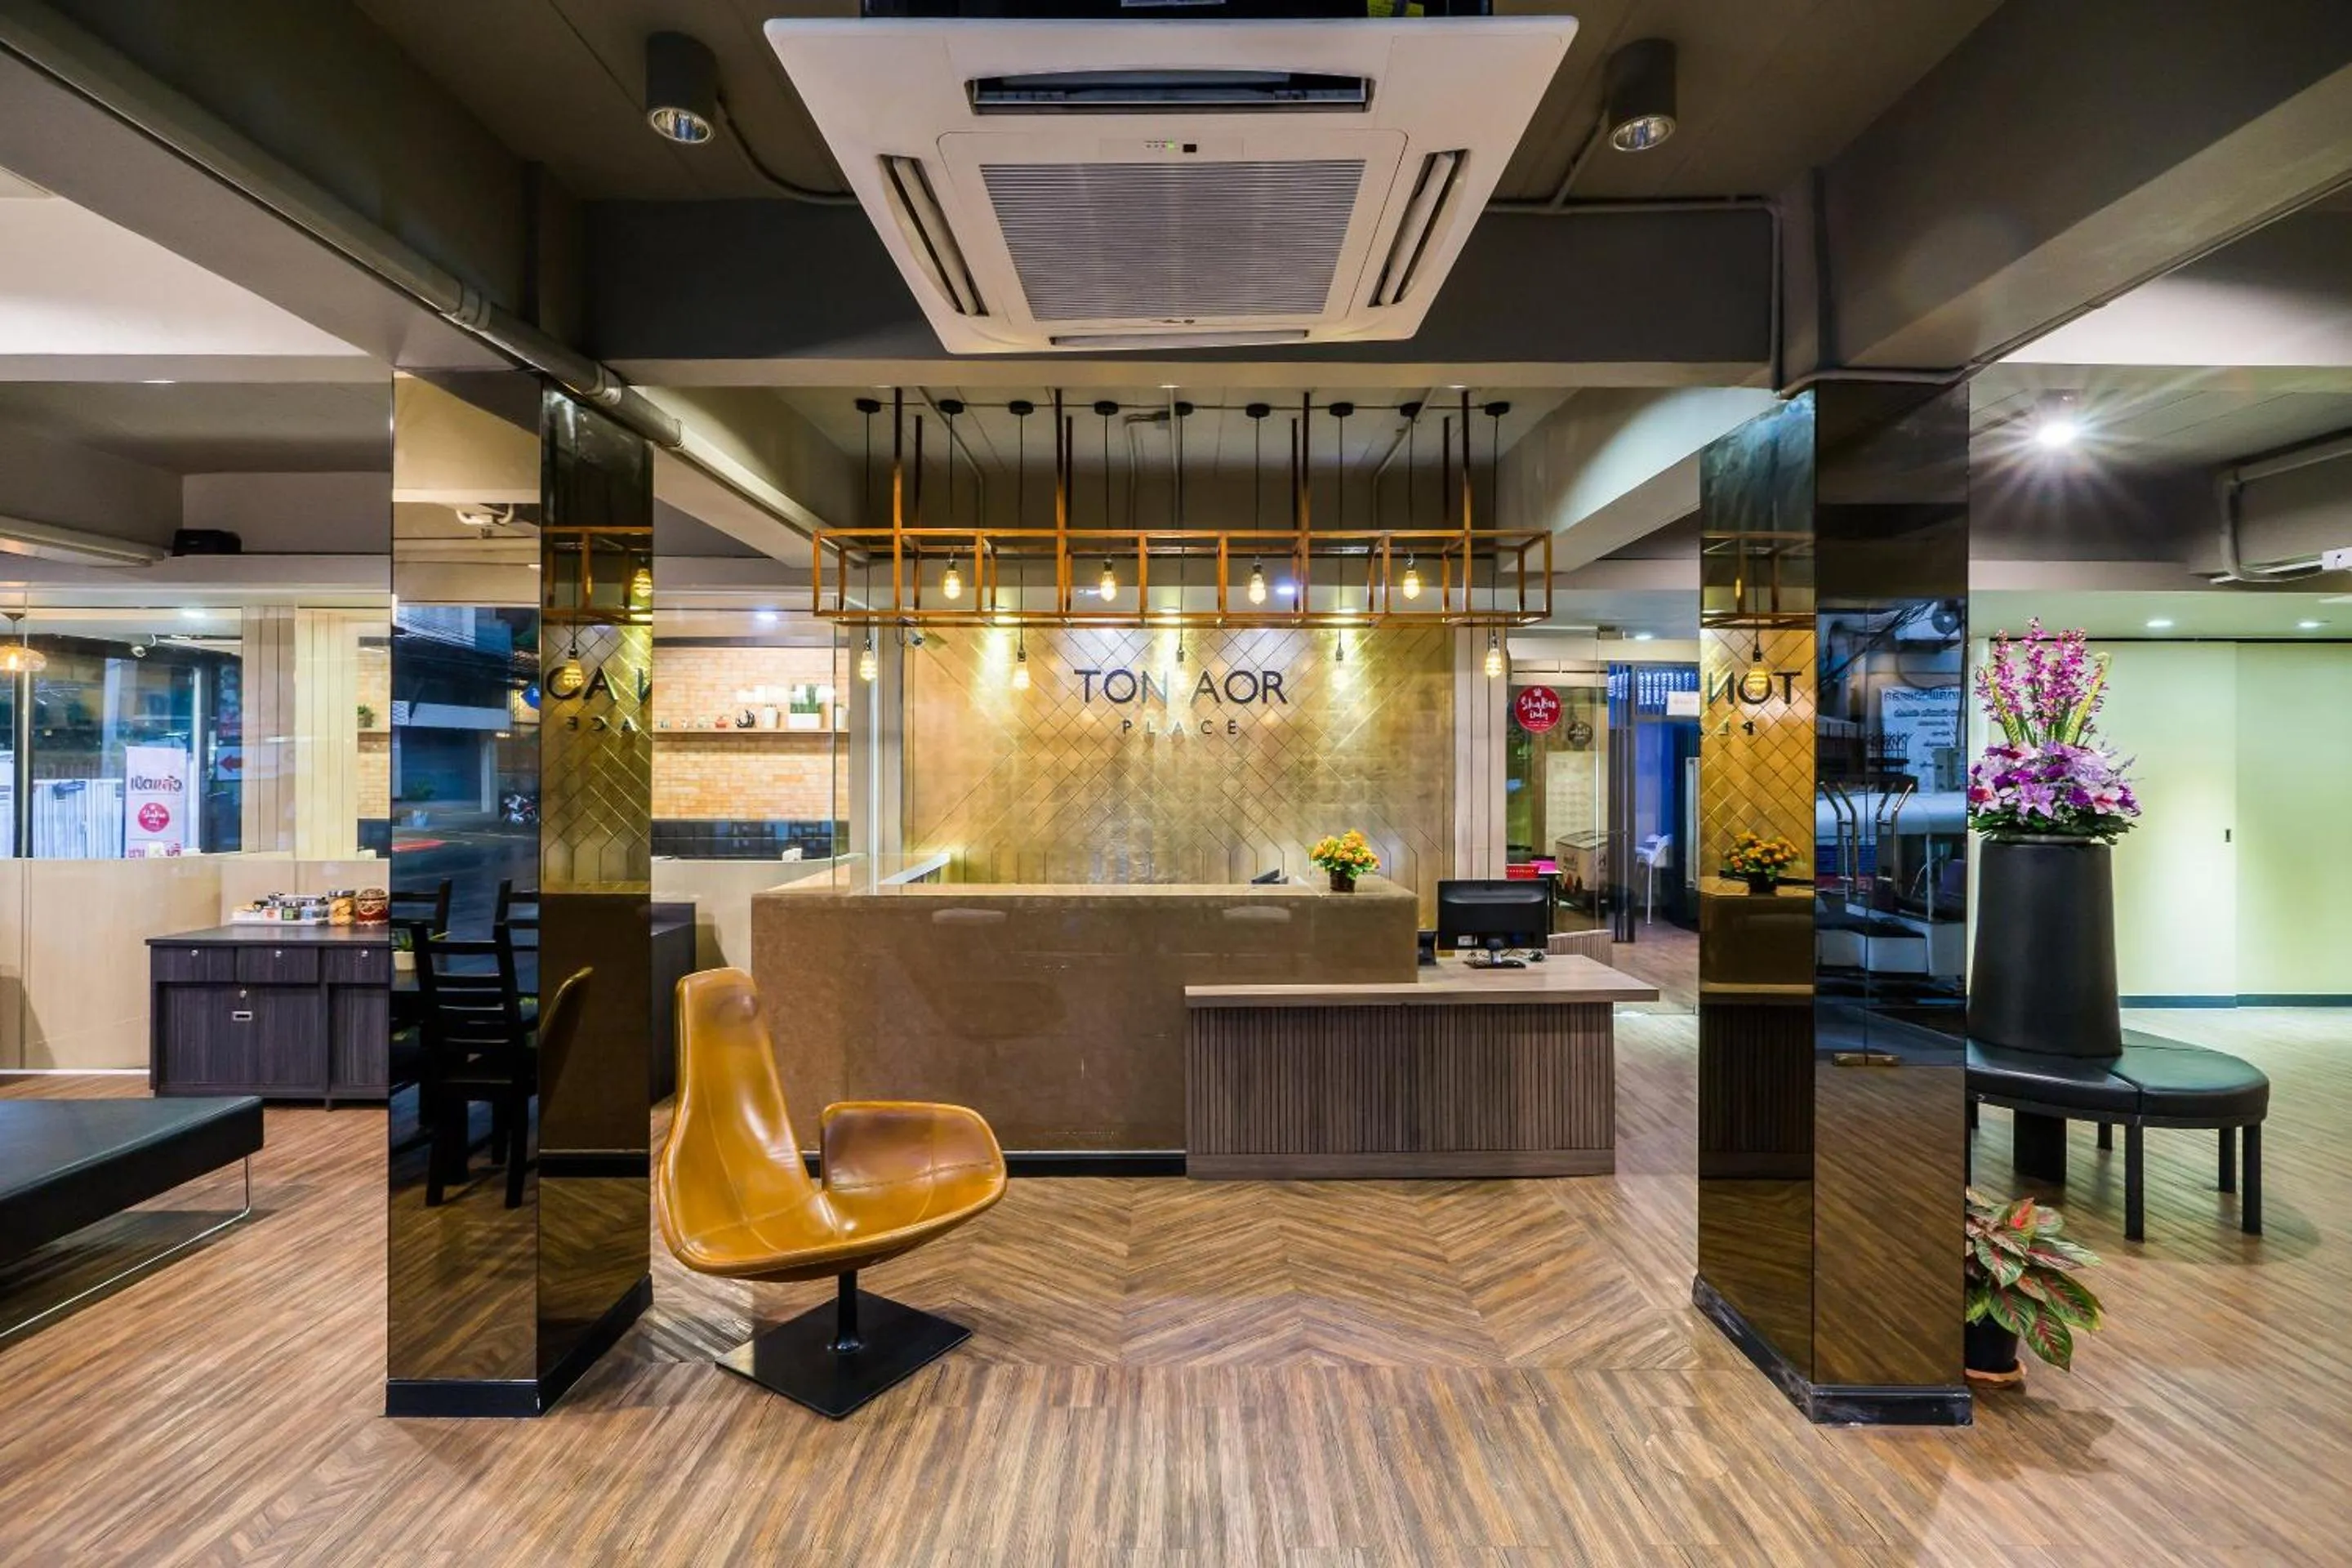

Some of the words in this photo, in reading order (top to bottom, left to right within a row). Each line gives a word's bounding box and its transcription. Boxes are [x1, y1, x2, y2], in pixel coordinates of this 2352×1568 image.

[1074, 668, 1168, 707] TON
[1190, 670, 1288, 705] AOR
[1122, 719, 1237, 735] PLACE
